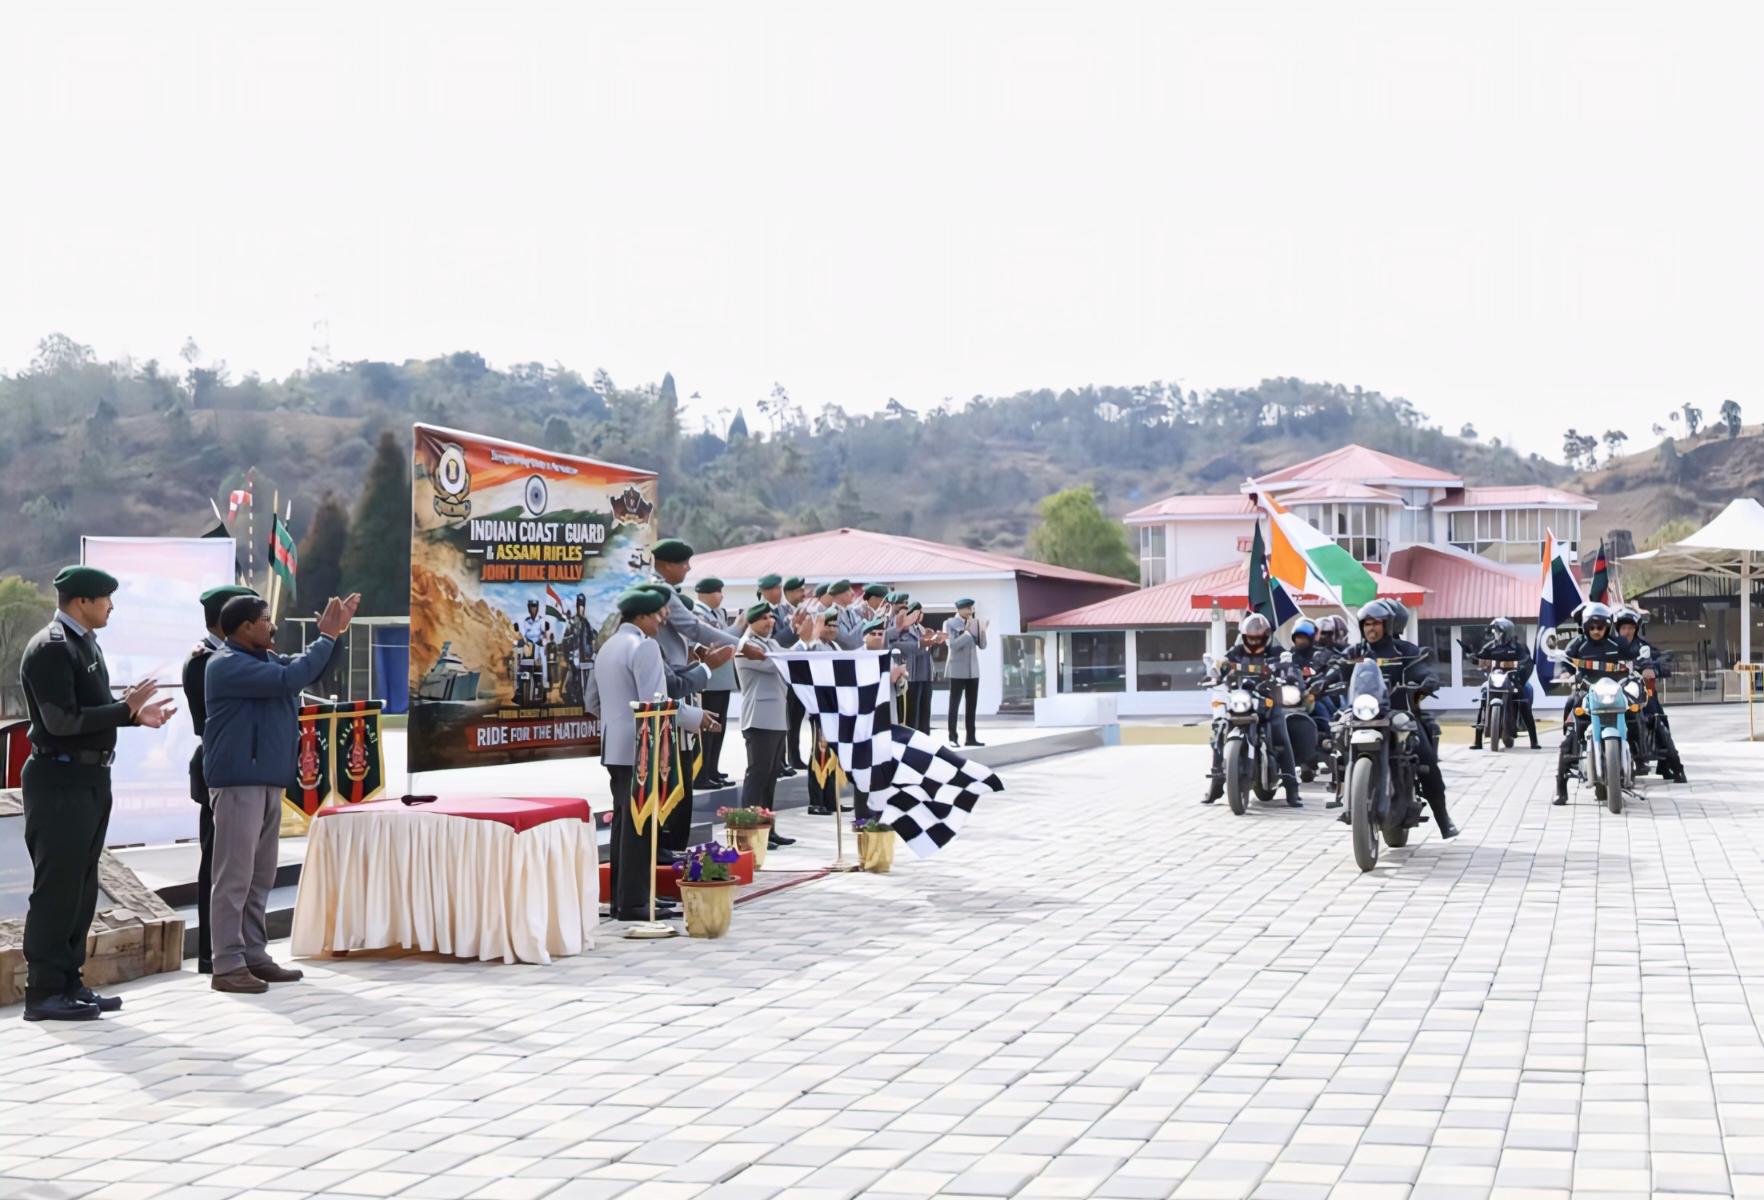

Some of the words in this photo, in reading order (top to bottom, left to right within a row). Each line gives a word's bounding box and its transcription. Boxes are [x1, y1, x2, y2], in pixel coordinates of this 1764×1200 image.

[470, 520, 516, 542] INDIAN
[519, 522, 558, 542] COAST
[565, 524, 605, 543] GUARD
[496, 544, 540, 560] ASSAM
[543, 546, 582, 561] RIFLES
[480, 564, 516, 580] JOINT
[548, 564, 583, 580] RALLY
[477, 726, 509, 747] RIDE
[511, 727, 530, 742] FOR
[533, 725, 552, 740] THE
